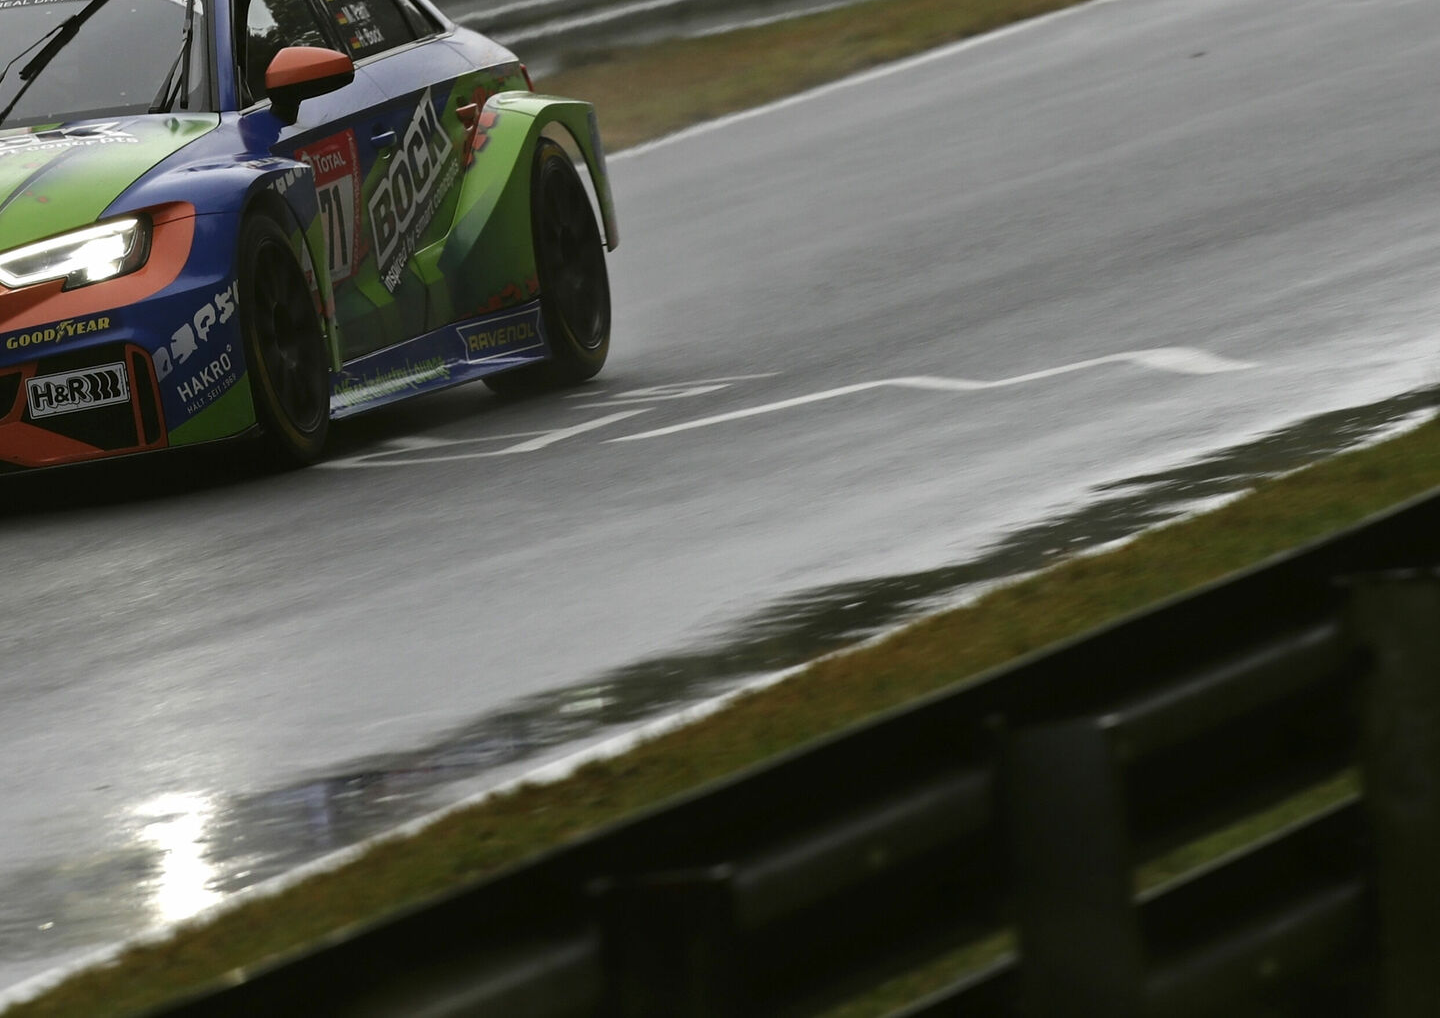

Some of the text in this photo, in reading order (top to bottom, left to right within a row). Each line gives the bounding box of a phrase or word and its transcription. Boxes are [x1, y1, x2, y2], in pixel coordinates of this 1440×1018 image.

[368, 87, 453, 270] BOCK
[6, 316, 111, 349] GOODYEAR
[467, 323, 536, 352] RAVENOL
[31, 379, 90, 411] H&R
[207, 385, 224, 402] SEIT
